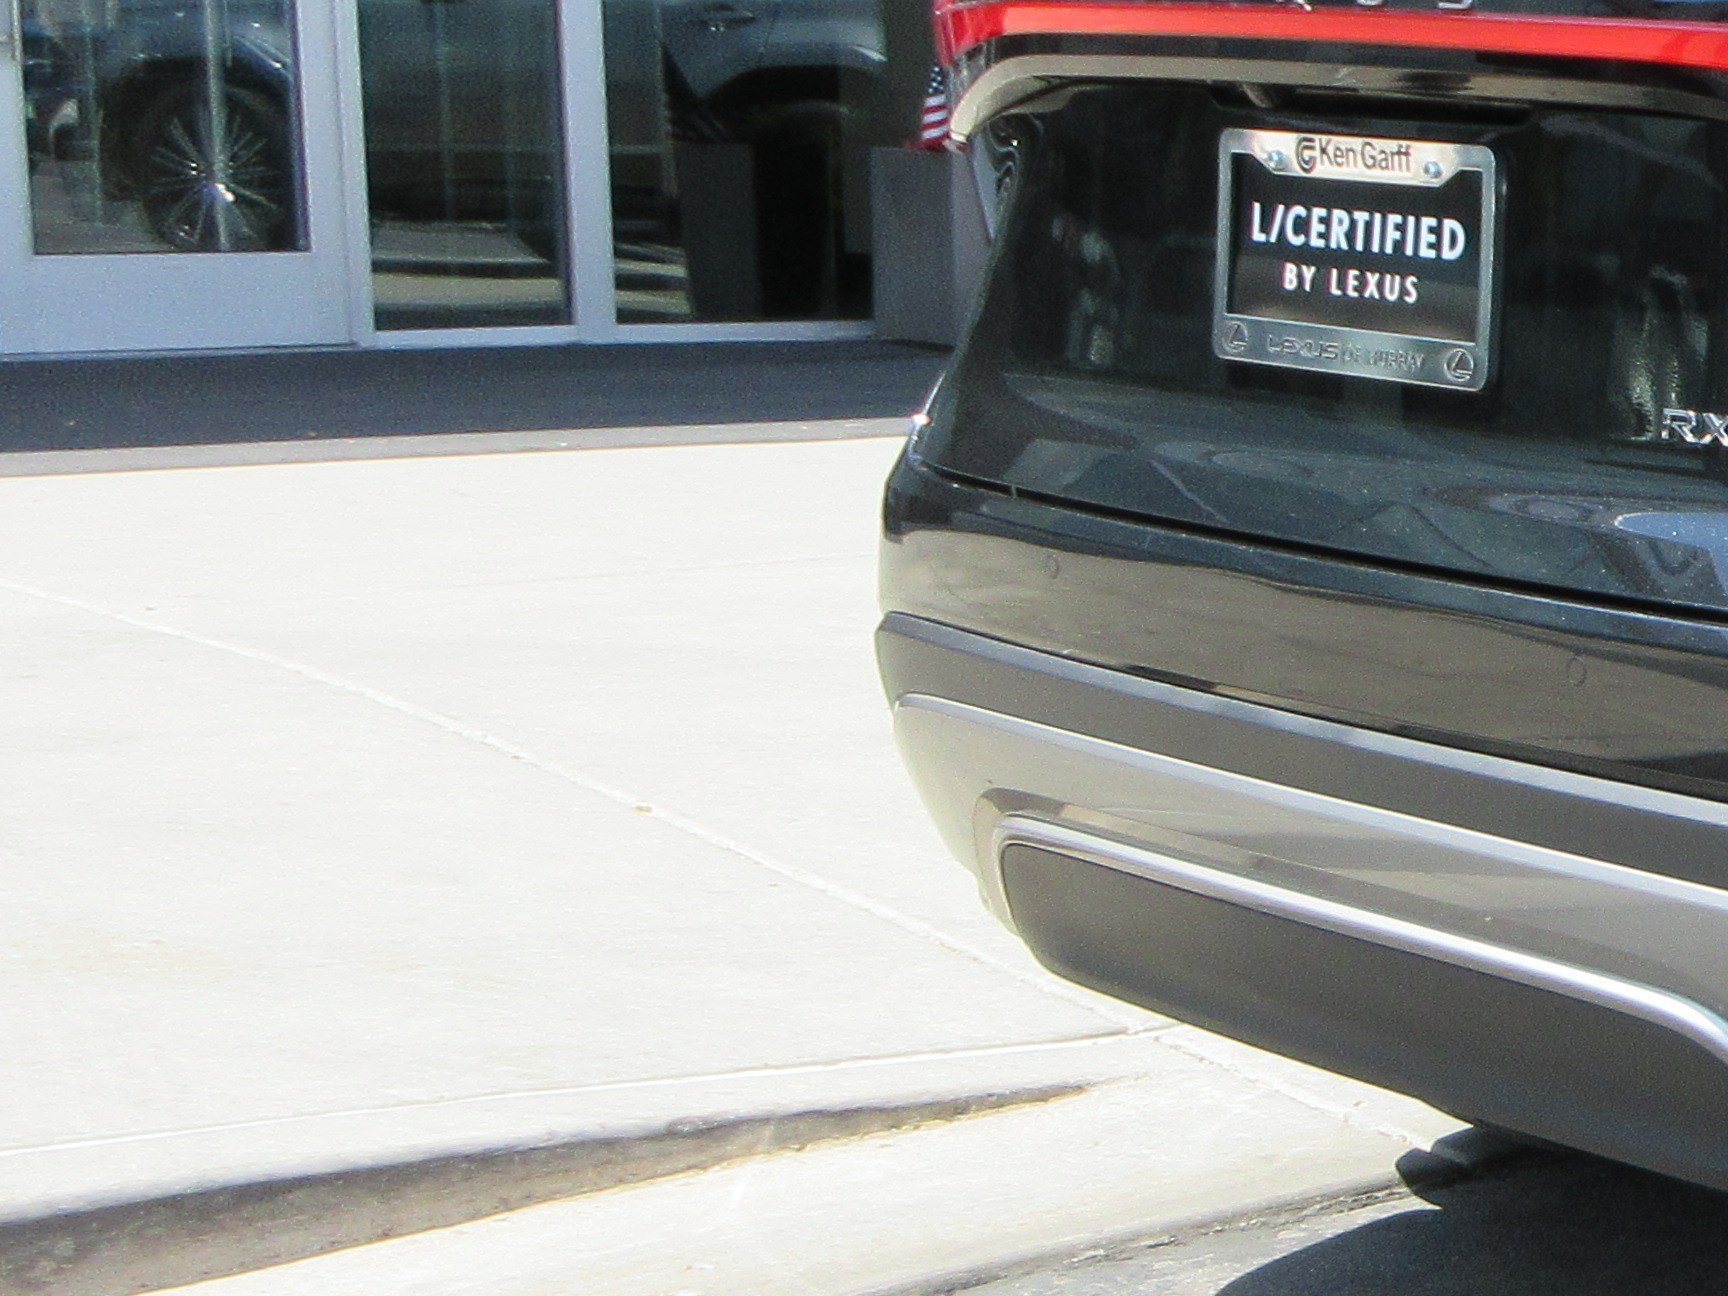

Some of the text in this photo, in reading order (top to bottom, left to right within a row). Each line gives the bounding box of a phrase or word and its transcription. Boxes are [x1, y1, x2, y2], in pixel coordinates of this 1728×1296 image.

[1318, 138, 1412, 172] Ken Garff
[1251, 202, 1466, 260] L/CERTIFIED
[1282, 262, 1418, 304] BY LEXUS
